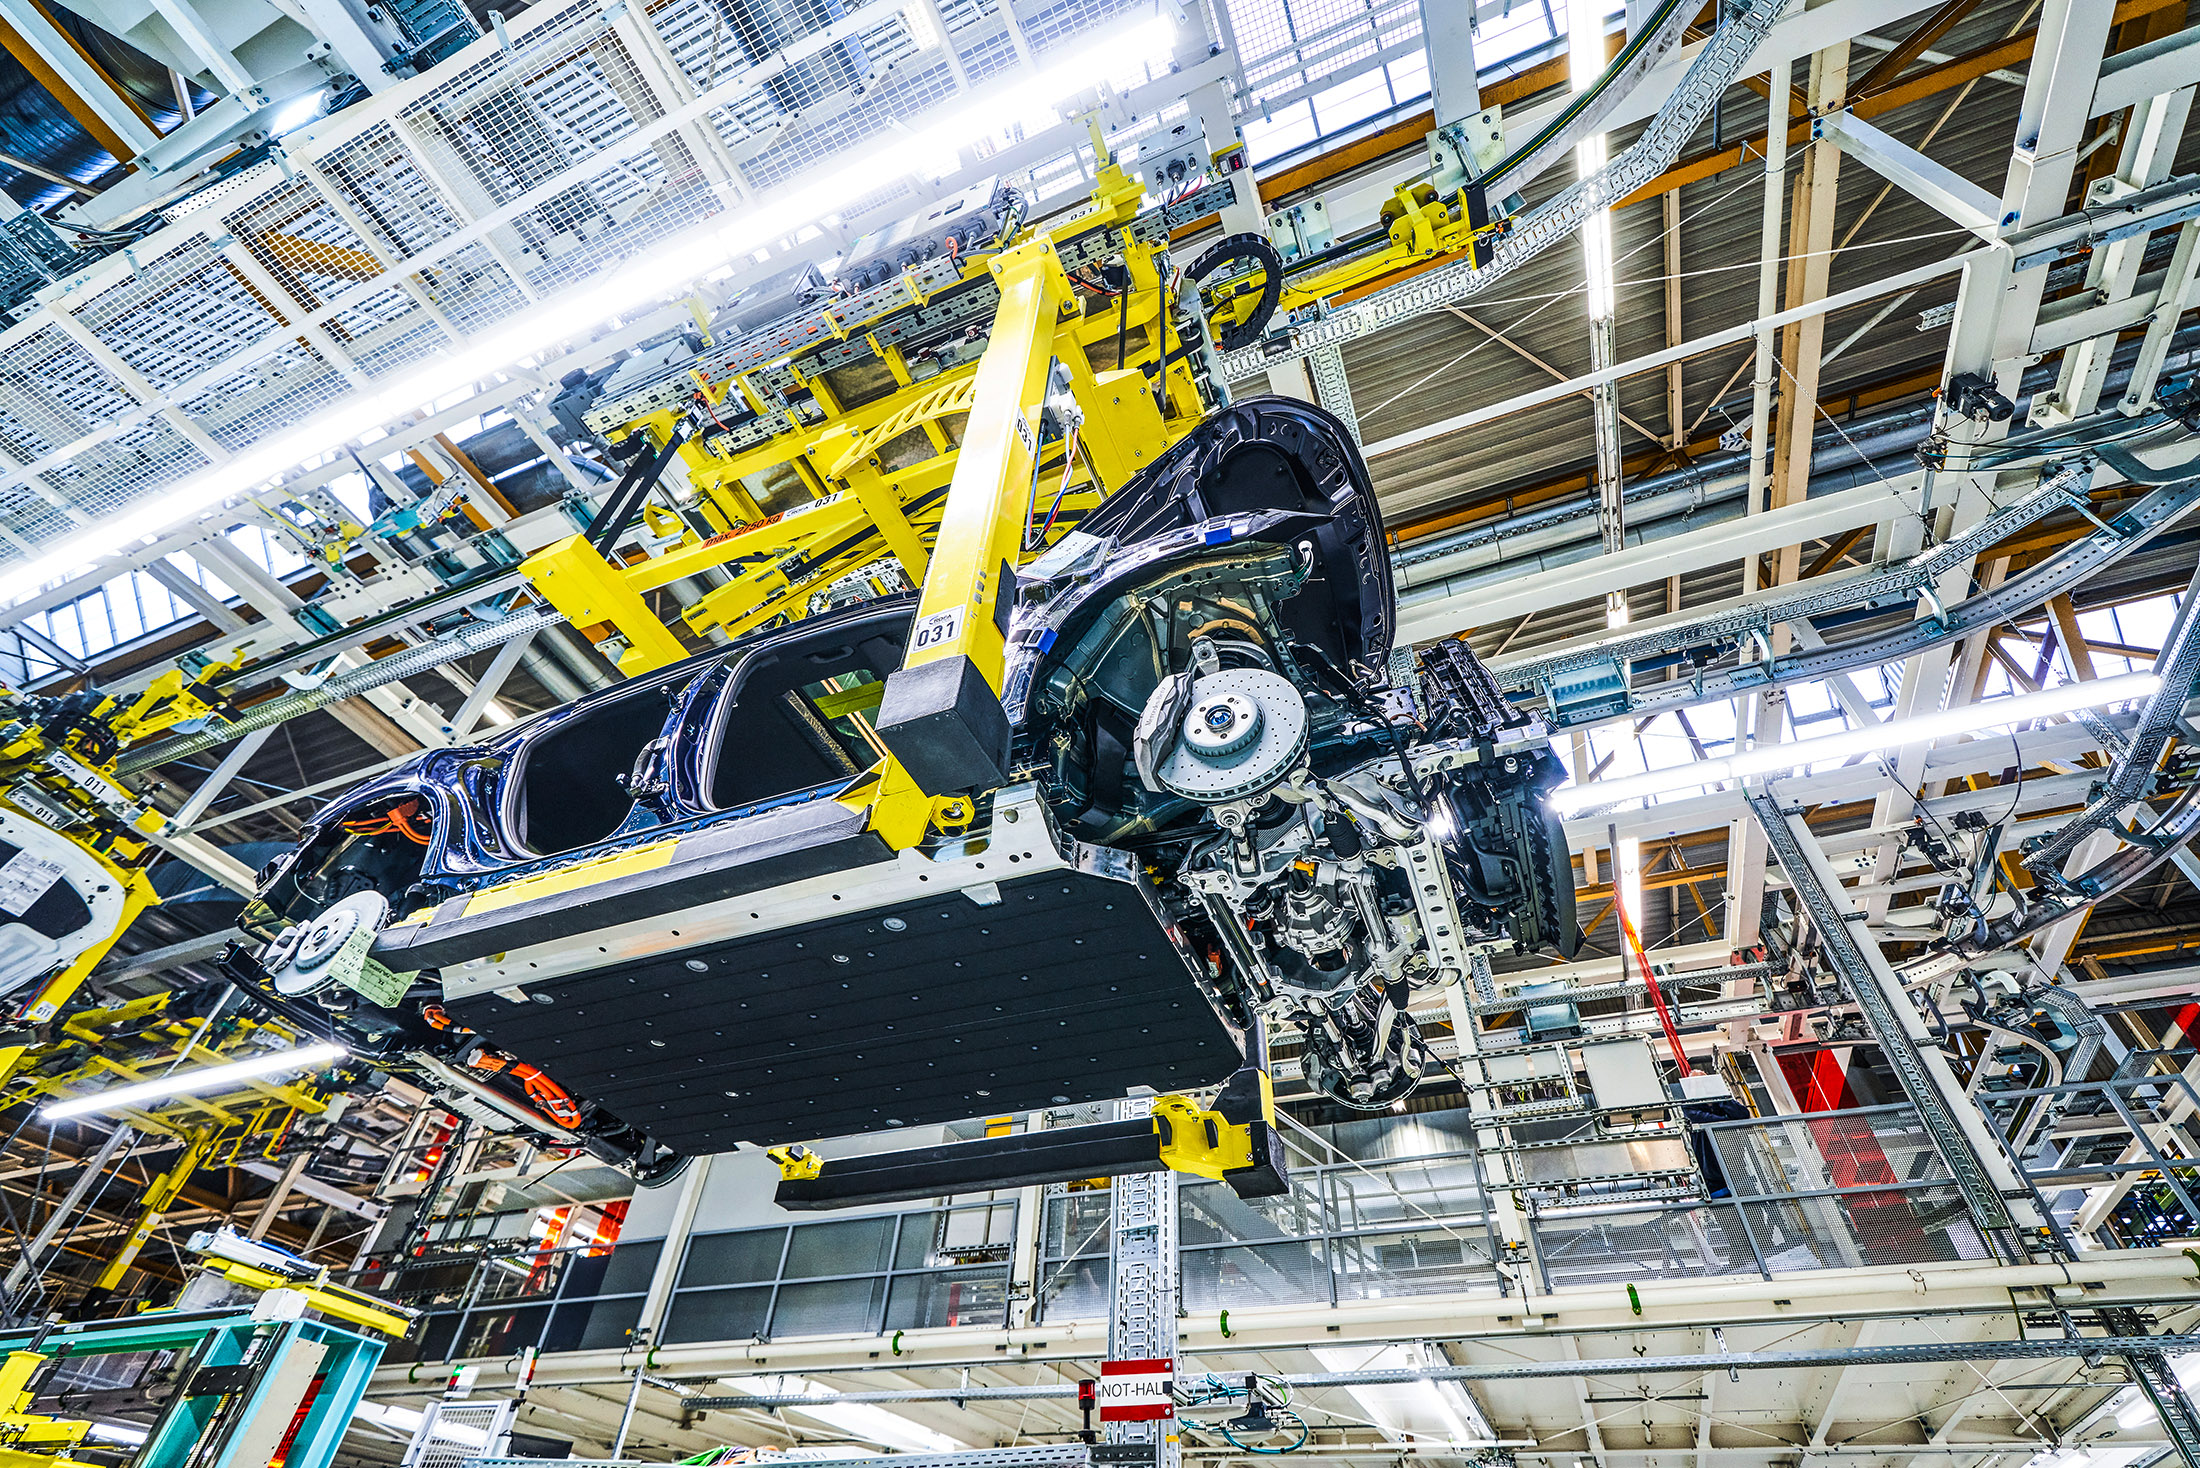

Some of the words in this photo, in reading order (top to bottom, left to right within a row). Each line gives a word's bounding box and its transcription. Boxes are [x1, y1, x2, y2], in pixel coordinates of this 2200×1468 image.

[1070, 207, 1093, 221] 031
[1017, 418, 1031, 451] 031
[815, 493, 838, 508] 031
[705, 532, 731, 546] max.
[766, 515, 781, 525] kg
[917, 620, 954, 647] 031
[84, 776, 107, 795] 011
[35, 807, 53, 822] 011
[36, 1006, 51, 1018] 011
[1101, 1381, 1164, 1398] NOT-HAL
